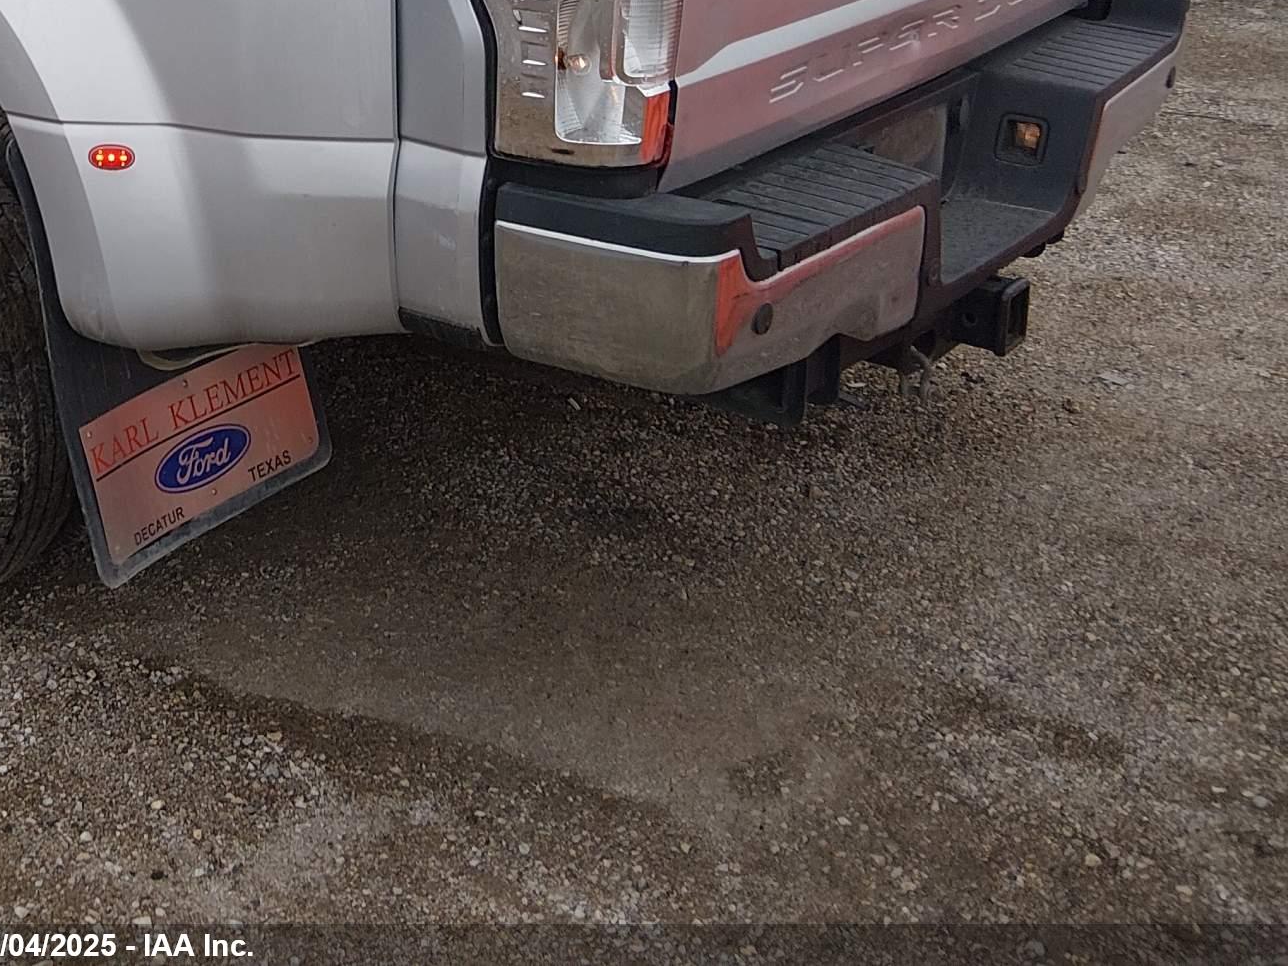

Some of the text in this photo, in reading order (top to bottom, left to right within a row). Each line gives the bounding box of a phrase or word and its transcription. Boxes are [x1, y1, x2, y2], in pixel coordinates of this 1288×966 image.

[769, 5, 962, 103] SUPER
[90, 349, 297, 475] KARL KLEMENT
[176, 436, 232, 485] Ford
[247, 450, 293, 483] TEXAS
[134, 507, 185, 546] DECATUR
